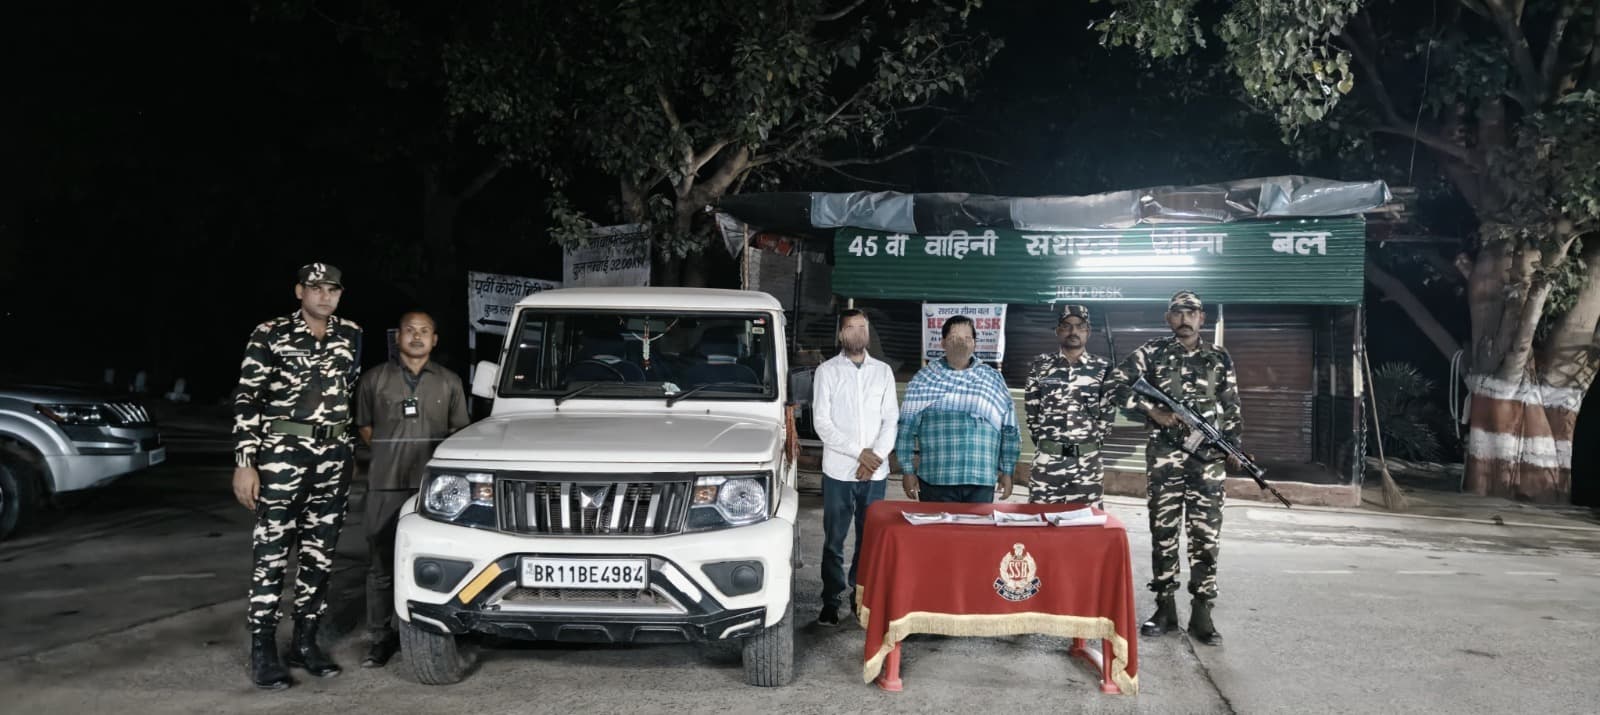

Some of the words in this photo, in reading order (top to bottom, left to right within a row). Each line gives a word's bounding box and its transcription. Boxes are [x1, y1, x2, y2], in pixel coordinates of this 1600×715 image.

[848, 235, 878, 256] 45
[924, 230, 998, 259] वाहिनी
[1269, 231, 1332, 255] बल
[1057, 285, 1088, 298] HELP
[1091, 285, 1123, 298] DESK
[534, 564, 643, 583] BR11BE4984
[1009, 561, 1027, 578] SSB
